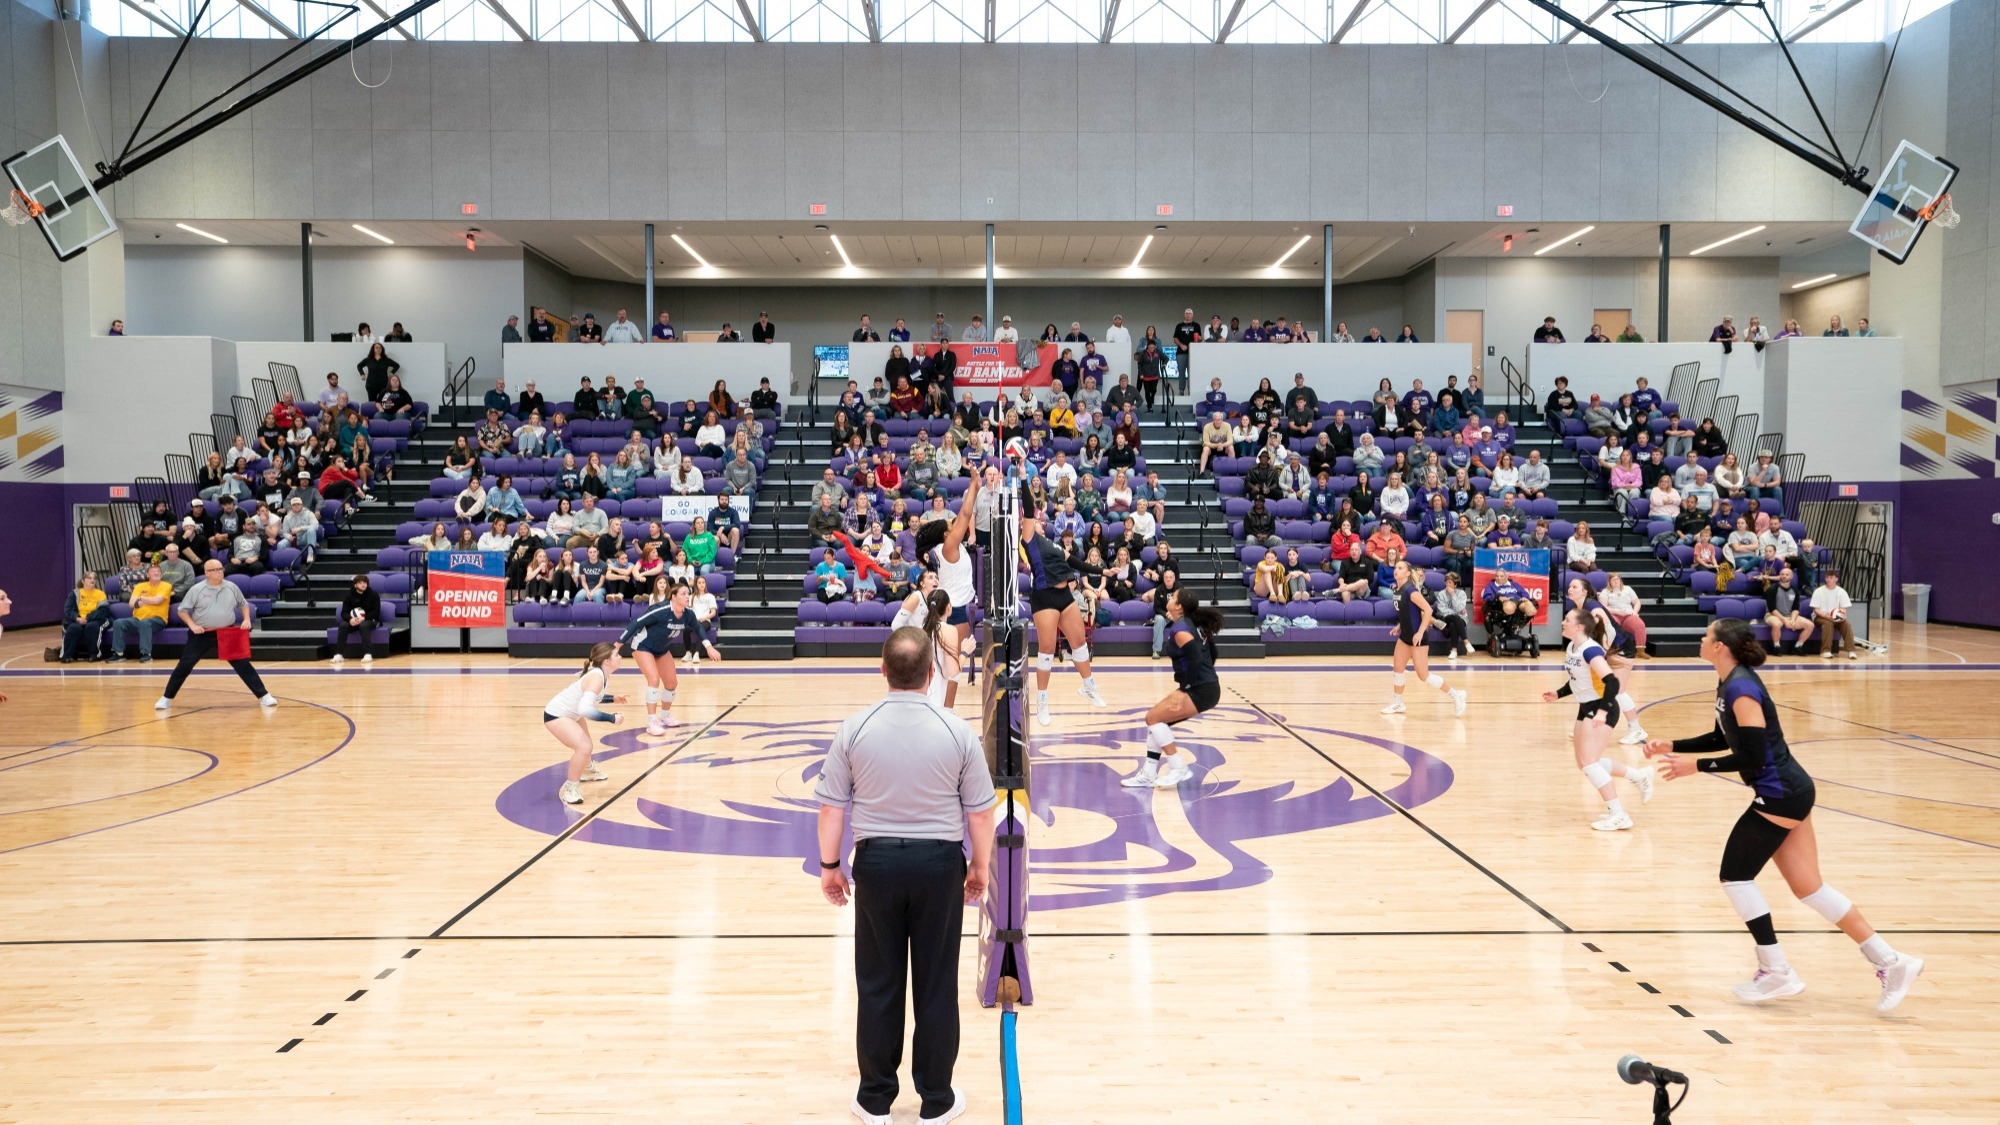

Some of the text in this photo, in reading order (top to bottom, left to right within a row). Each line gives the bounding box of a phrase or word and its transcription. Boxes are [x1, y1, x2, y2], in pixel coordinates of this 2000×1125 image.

[973, 346, 999, 357] NAIA
[973, 366, 1024, 378] BANNER
[112, 487, 125, 497] EXIT
[677, 500, 690, 508] GO
[665, 508, 704, 516] COUGARS
[450, 553, 483, 570] NAIA
[1496, 552, 1529, 567] NAIA
[434, 589, 499, 603] OPENING
[441, 605, 492, 618] ROUND
